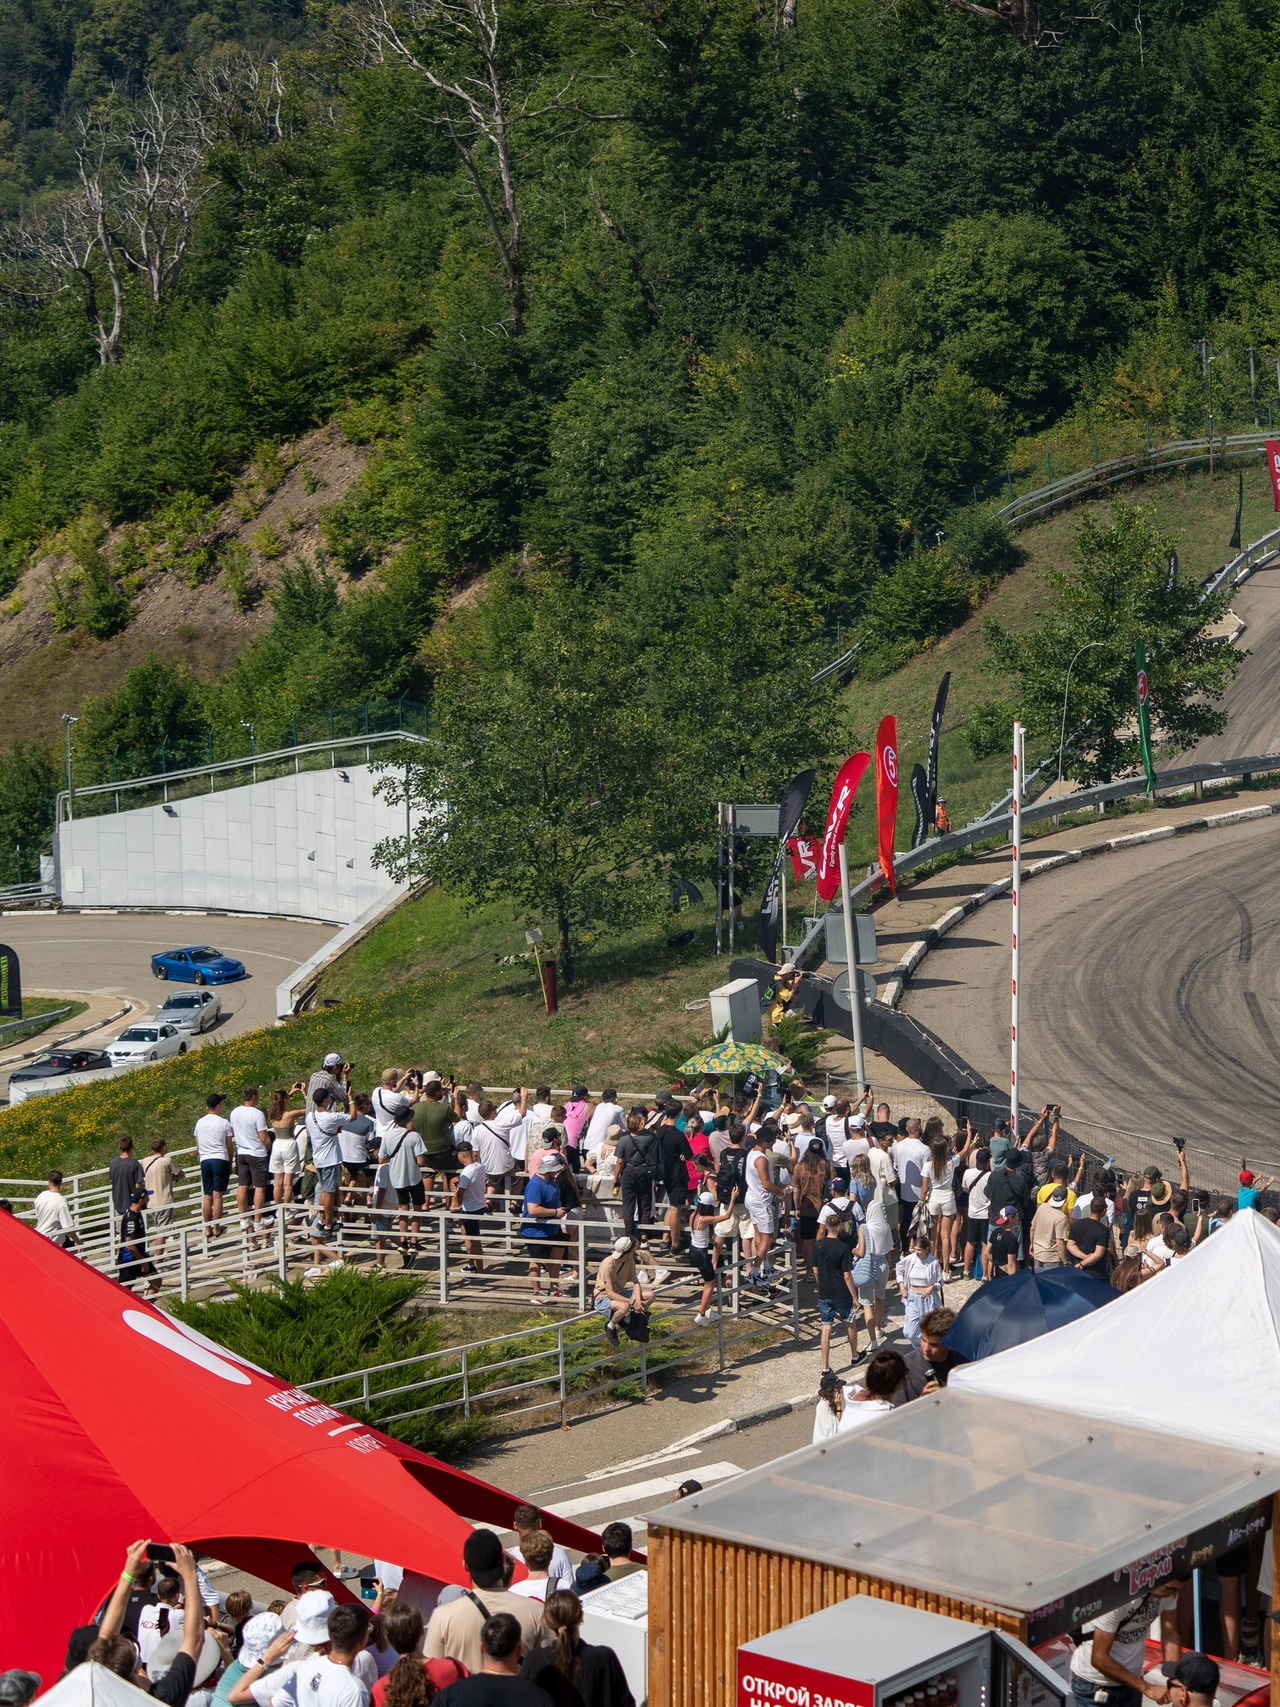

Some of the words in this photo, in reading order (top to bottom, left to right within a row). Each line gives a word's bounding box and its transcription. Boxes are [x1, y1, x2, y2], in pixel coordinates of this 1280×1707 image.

[820, 785, 851, 880] LAVR
[264, 1388, 320, 1412] КРАСНА
[292, 1404, 344, 1427] ПОЛЯНА
[742, 1675, 810, 1707] ОТКРОЙ
